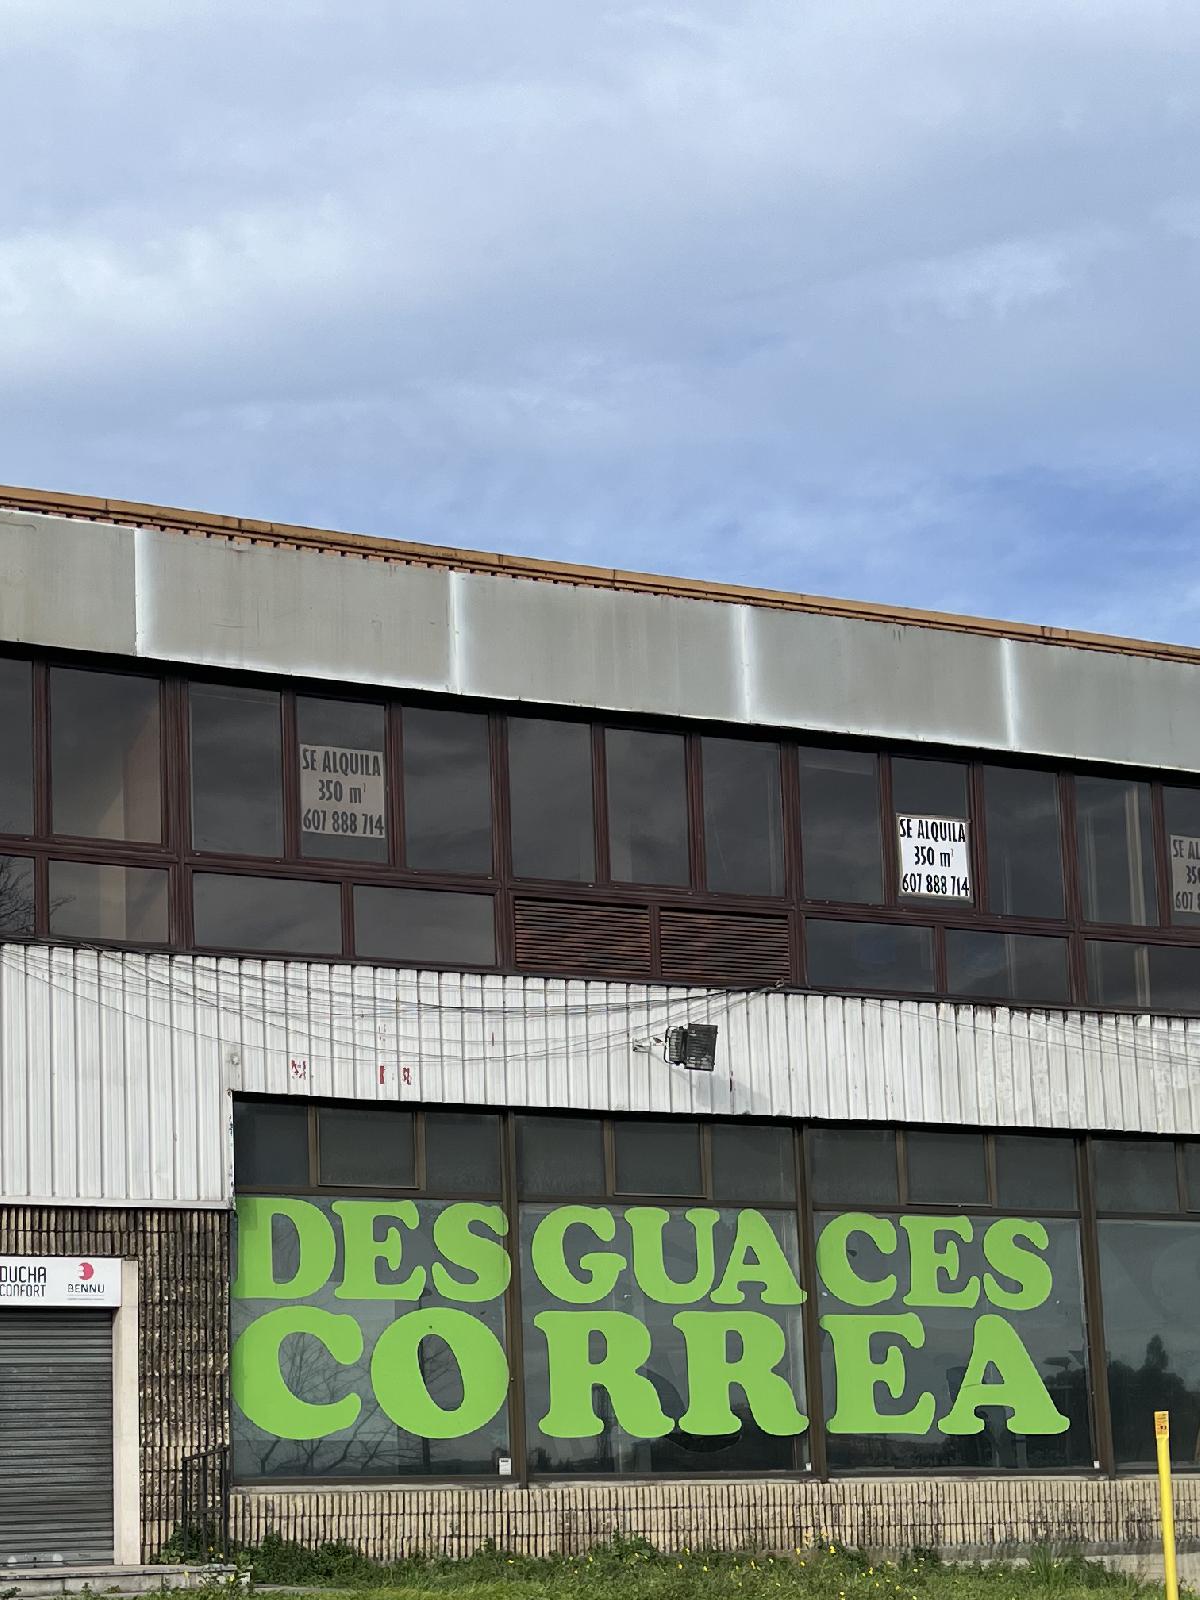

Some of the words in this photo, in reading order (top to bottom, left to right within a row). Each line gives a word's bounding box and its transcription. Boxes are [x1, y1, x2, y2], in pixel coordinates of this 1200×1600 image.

[302, 748, 317, 771] SE
[322, 750, 381, 777] ALQUILA
[318, 779, 343, 802] 350
[303, 808, 327, 831] 607
[331, 810, 358, 834] 888
[362, 813, 385, 836] 714
[899, 818, 912, 839] SE
[917, 819, 966, 843] ALQUILA
[914, 845, 935, 866] 350
[1172, 839, 1185, 858] SE
[902, 872, 922, 893] 607
[926, 874, 947, 895] 888
[950, 875, 970, 897] 714
[1175, 891, 1194, 911] 607
[0, 1265, 47, 1284] DUCHA
[0, 1284, 47, 1298] CONFORT
[67, 1283, 105, 1294] BENNU
[231, 1305, 1071, 1441] CORREA
